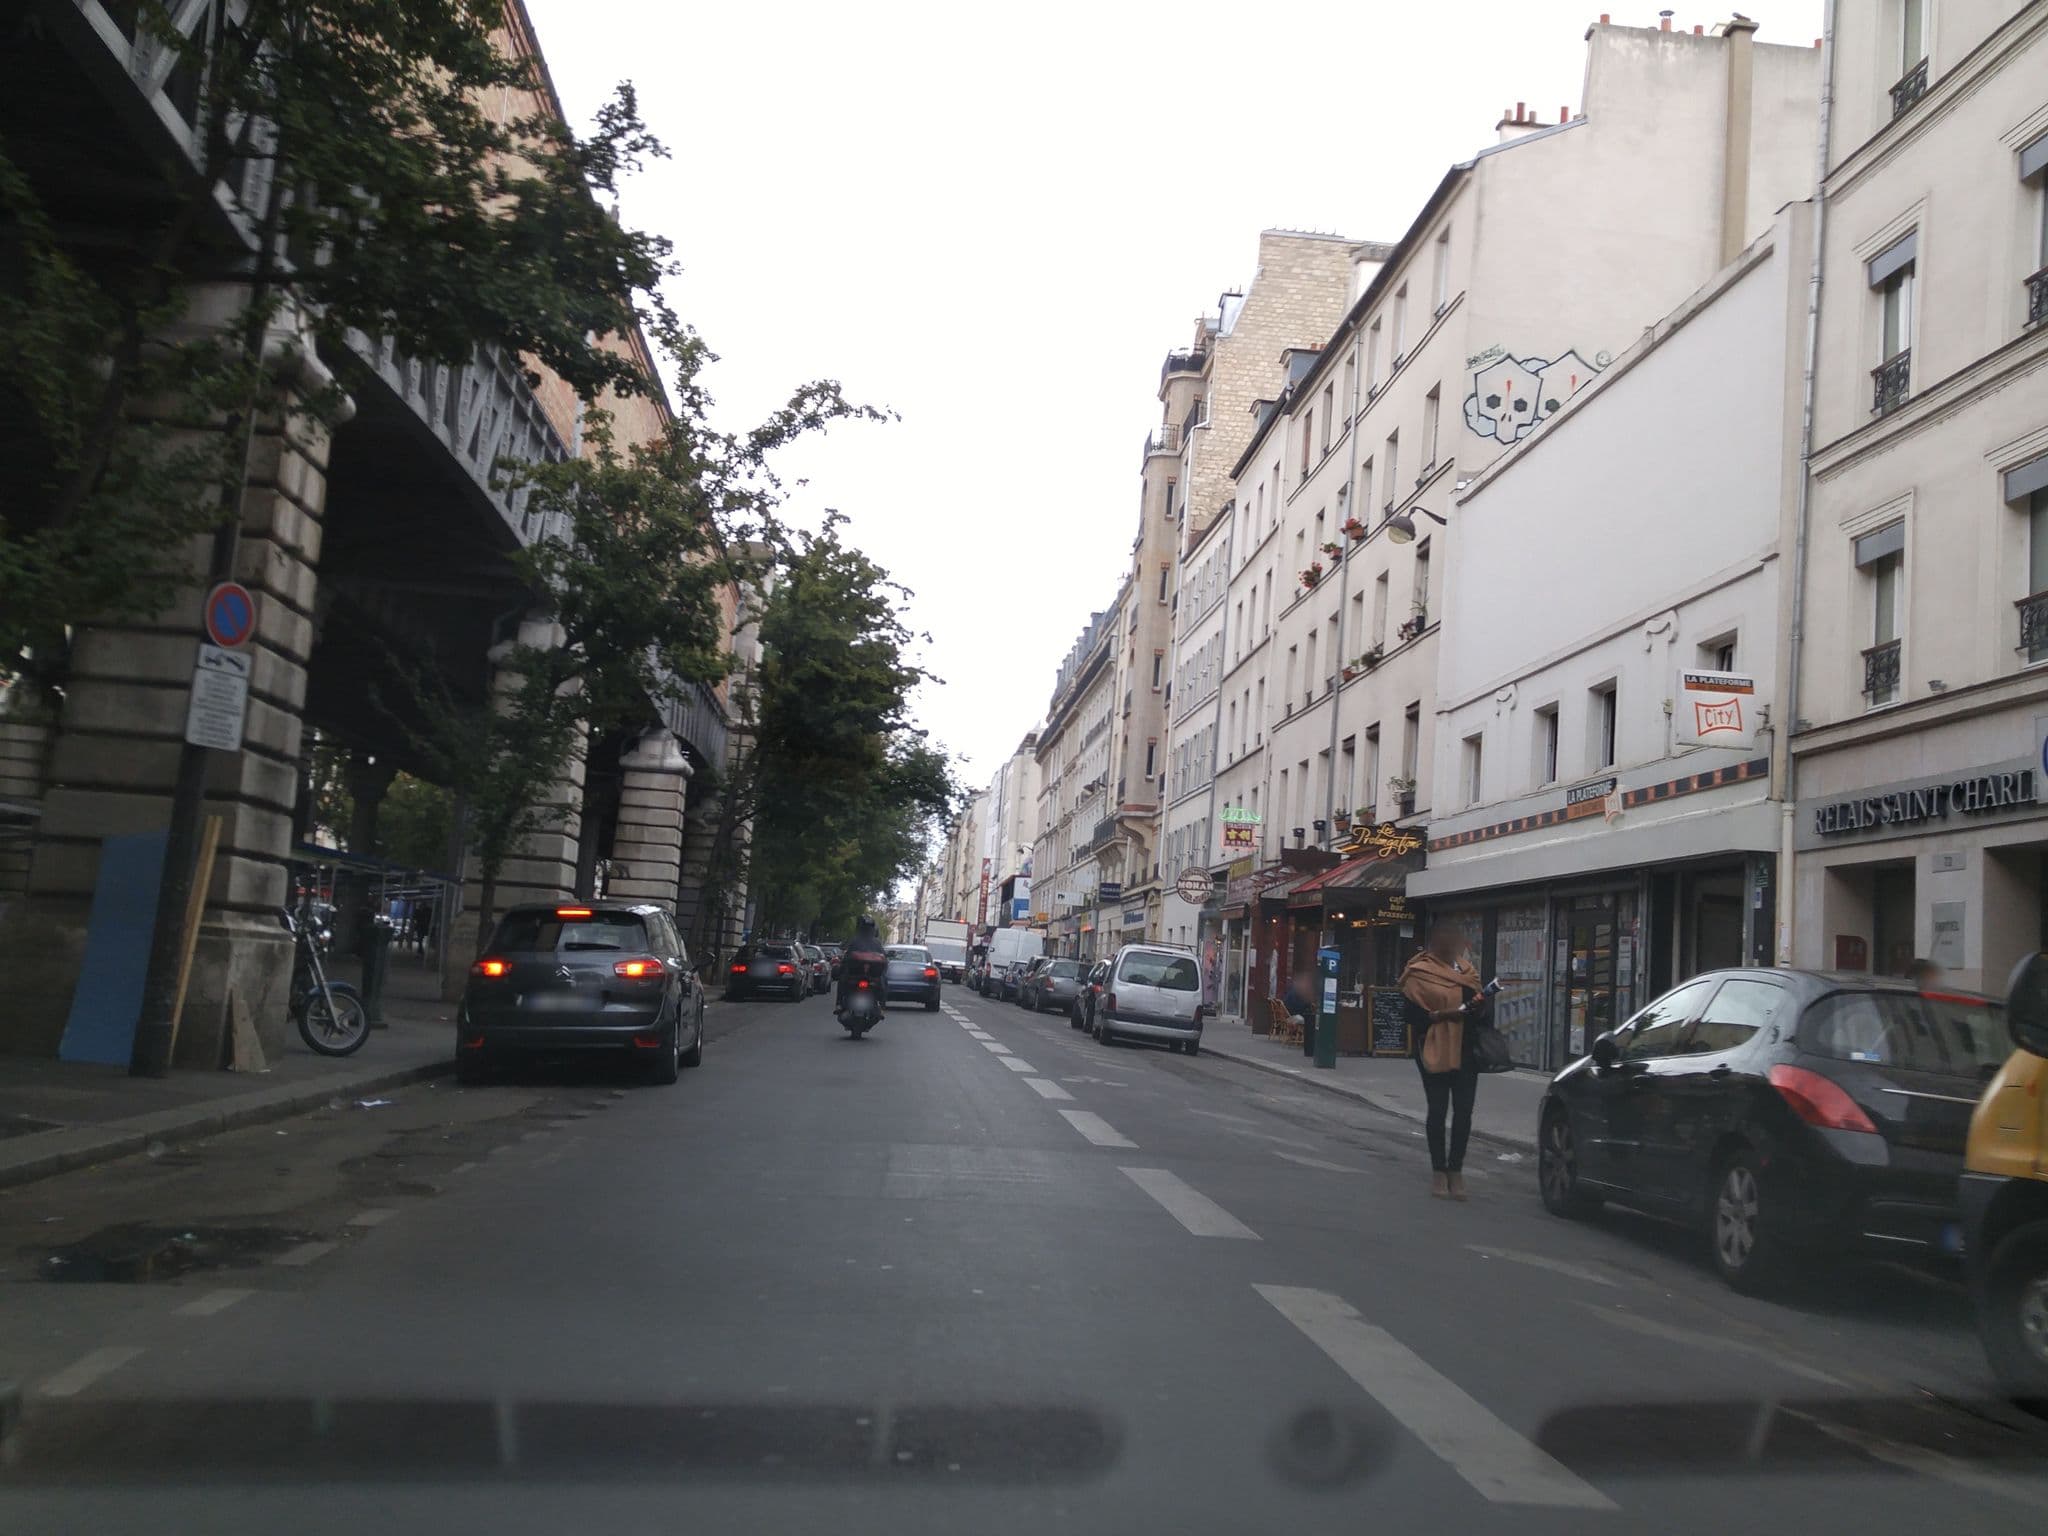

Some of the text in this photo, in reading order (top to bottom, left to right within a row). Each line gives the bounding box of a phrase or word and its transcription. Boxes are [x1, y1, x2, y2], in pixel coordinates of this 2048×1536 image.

[1687, 675, 1698, 683] LA
[1700, 677, 1752, 687] PLATEFORME
[1815, 800, 1876, 834] RELAIS
[1880, 785, 1943, 824] SAINT
[1377, 823, 1396, 838] Les
[1353, 827, 1422, 857] Prolongations
[1328, 959, 1337, 970] P
